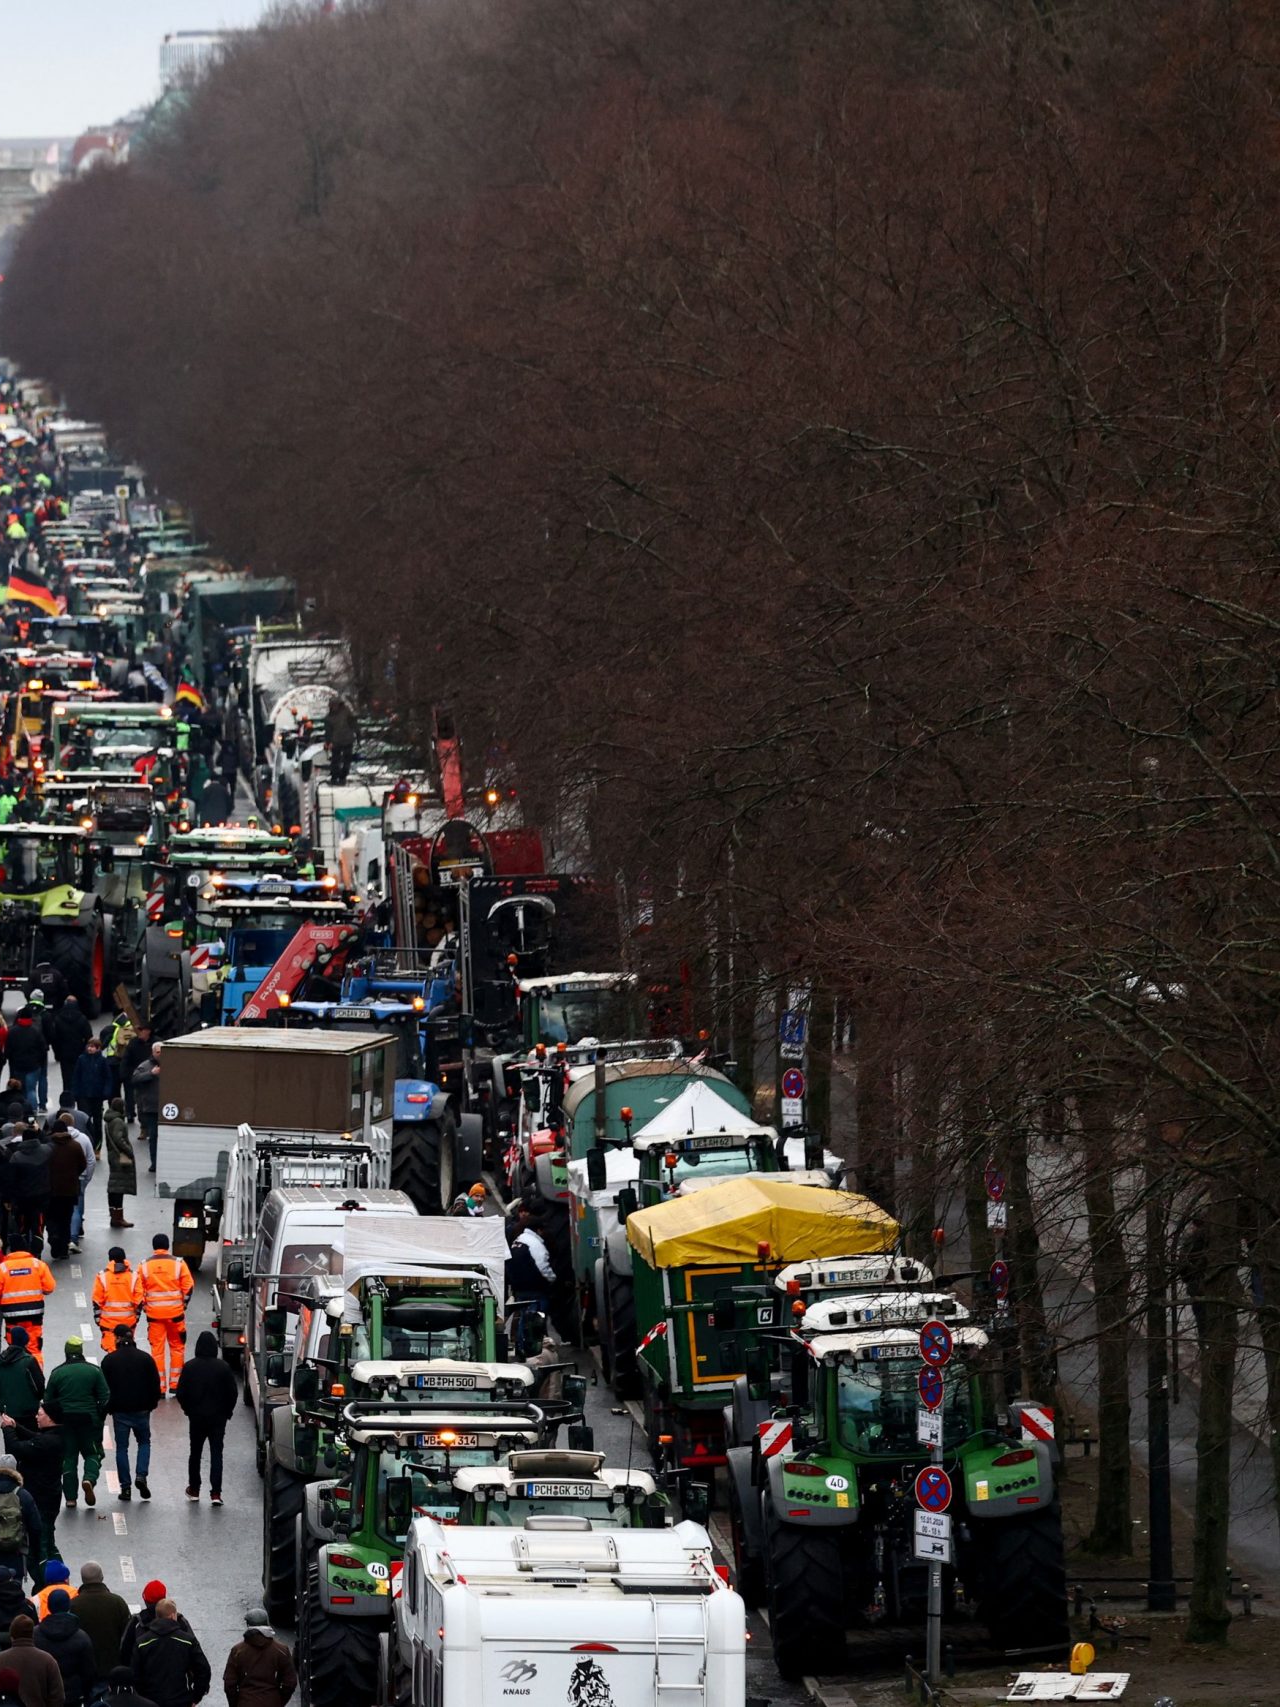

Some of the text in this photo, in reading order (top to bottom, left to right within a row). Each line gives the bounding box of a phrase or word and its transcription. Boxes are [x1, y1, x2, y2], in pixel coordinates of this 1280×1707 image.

[165, 1107, 176, 1117] 25
[423, 1376, 474, 1387] WB PH 500
[423, 1435, 436, 1446] WB
[534, 1482, 591, 1496] PCH GK 156
[830, 1478, 844, 1489] 40
[371, 1564, 386, 1577] 40
[502, 1688, 531, 1696] KNAUS
